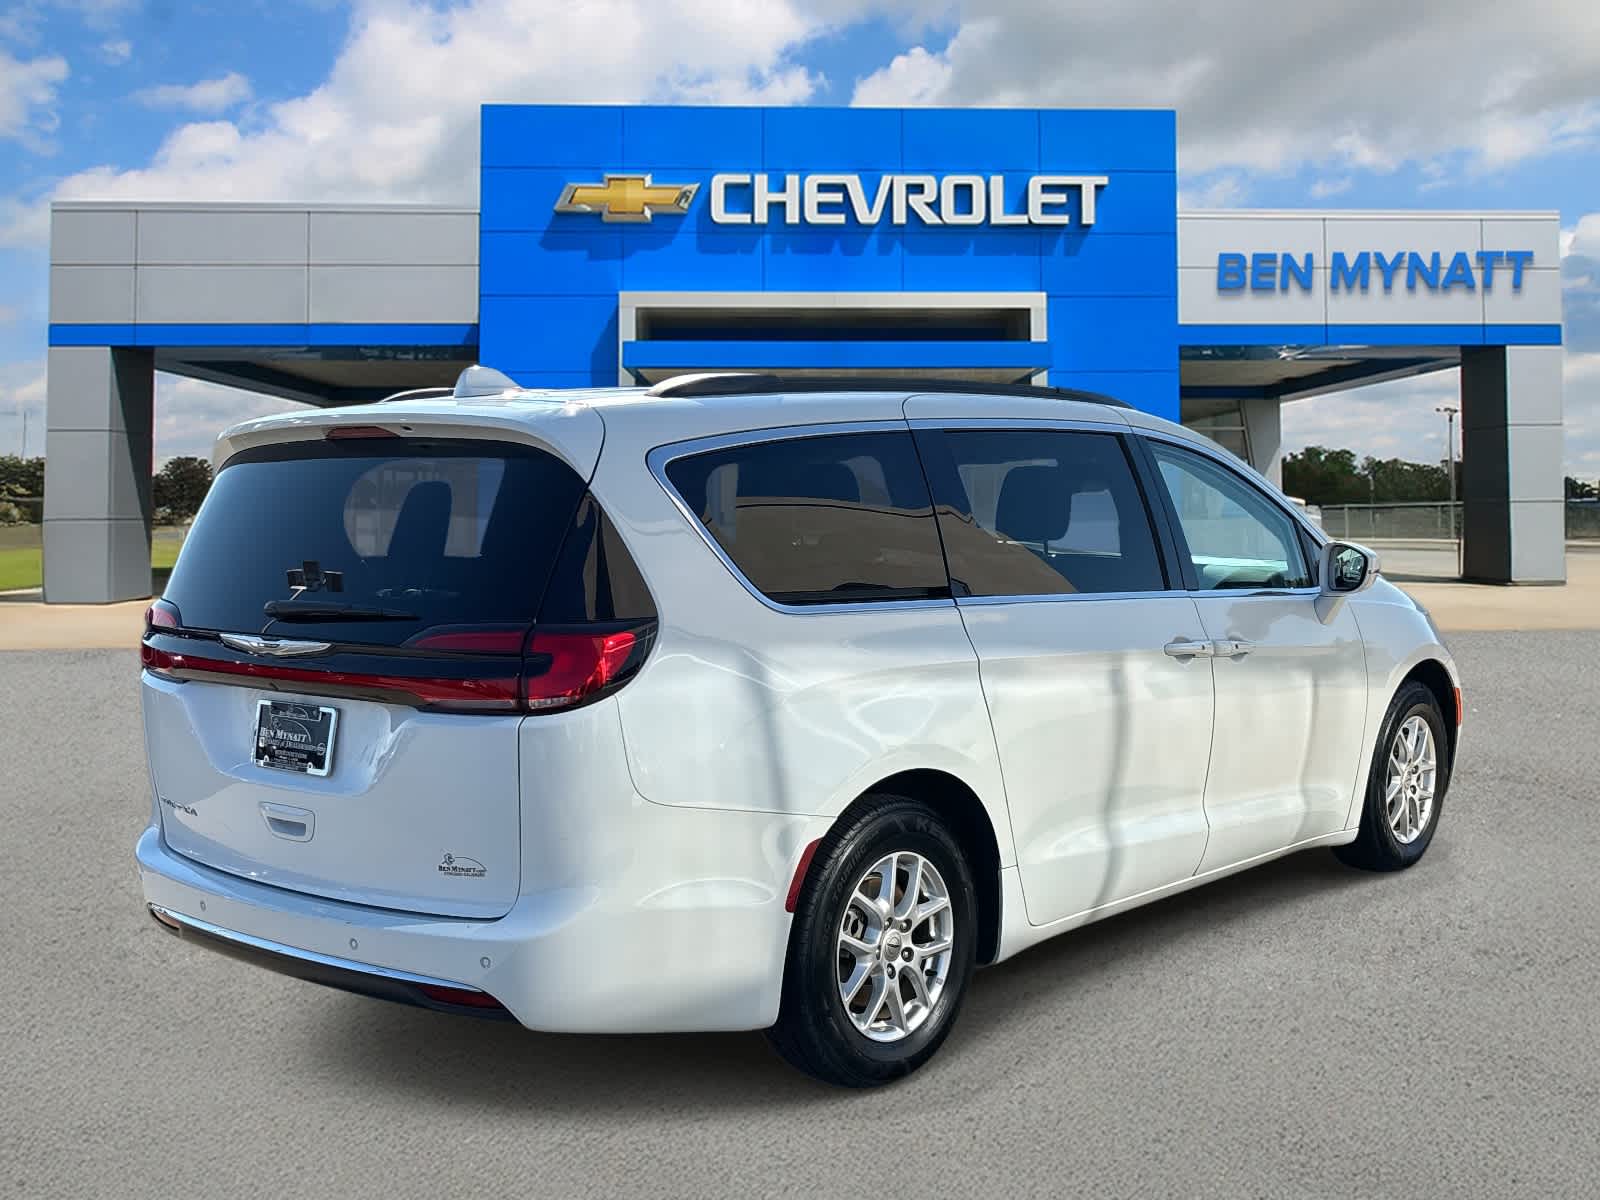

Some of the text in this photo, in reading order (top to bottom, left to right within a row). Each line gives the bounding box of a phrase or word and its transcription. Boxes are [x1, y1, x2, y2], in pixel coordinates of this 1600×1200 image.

[711, 174, 1109, 225] CHEVROLET
[1217, 250, 1534, 290] BEN MYNATT
